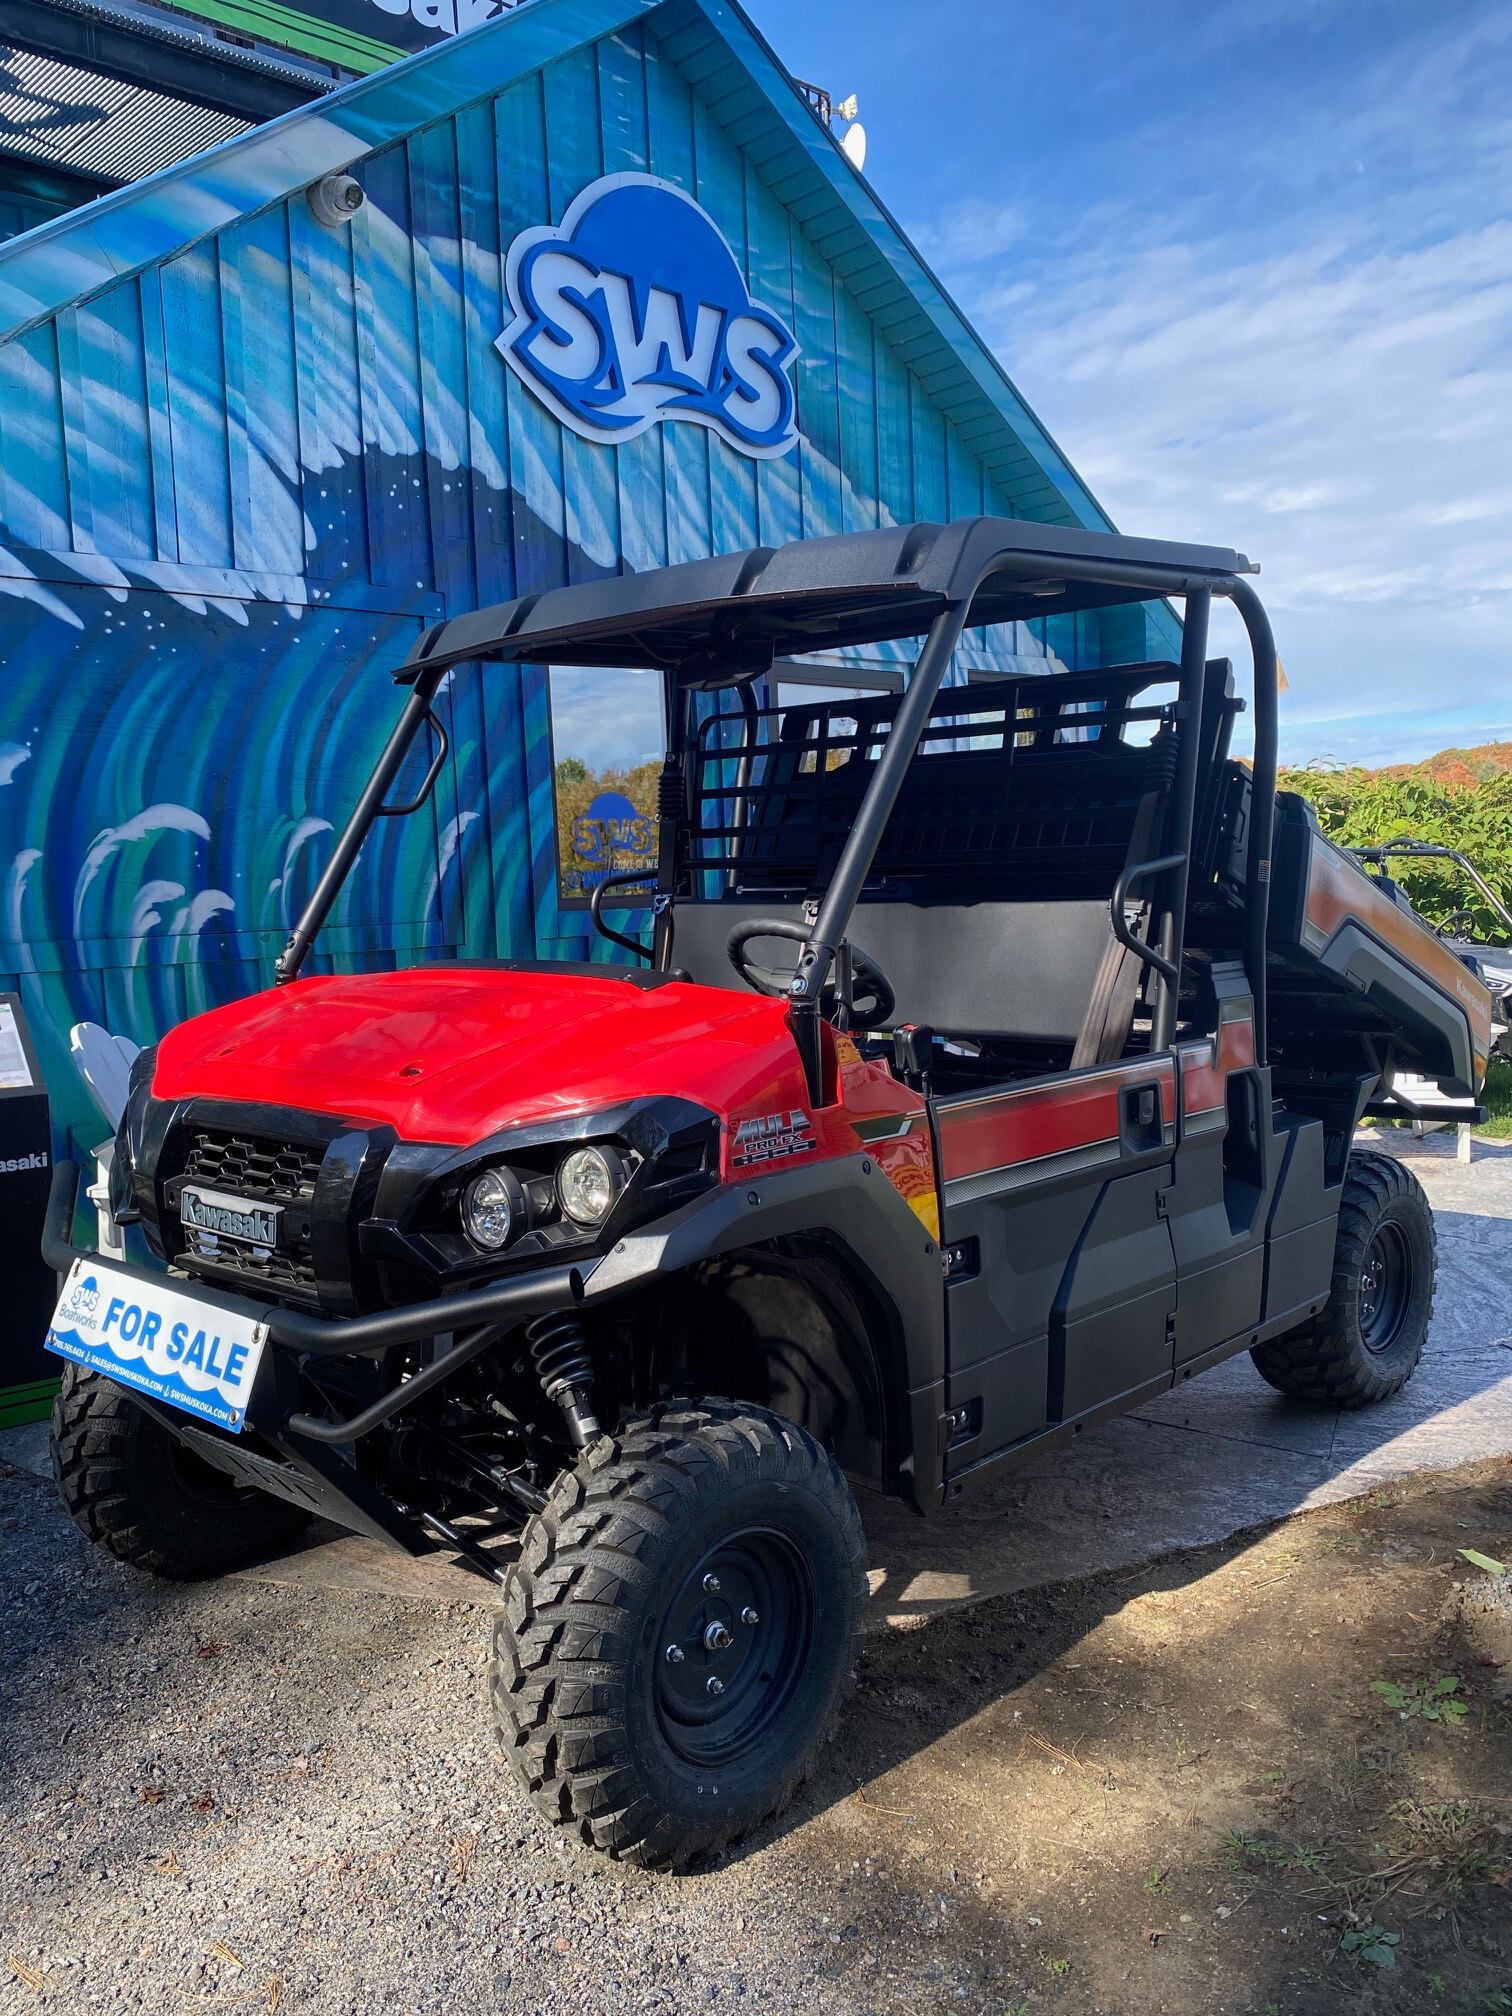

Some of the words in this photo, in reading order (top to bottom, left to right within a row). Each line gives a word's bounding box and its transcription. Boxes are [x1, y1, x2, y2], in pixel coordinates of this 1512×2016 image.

[522, 247, 790, 436] SWS
[576, 817, 650, 852] SWS
[1456, 976, 1488, 1020] Kawasaki
[732, 1108, 812, 1146] MULE
[741, 1141, 810, 1165] 1000
[183, 1193, 275, 1243] Kawasaki
[59, 1303, 98, 1330] Boatworks
[71, 1285, 100, 1311] SWS
[102, 1297, 162, 1351] FOR
[166, 1322, 250, 1387] SALE
[91, 1354, 163, 1393] SALES@SWSMUSKOKA.COM
[170, 1389, 229, 1421] SWSMUSKOKA.COM
